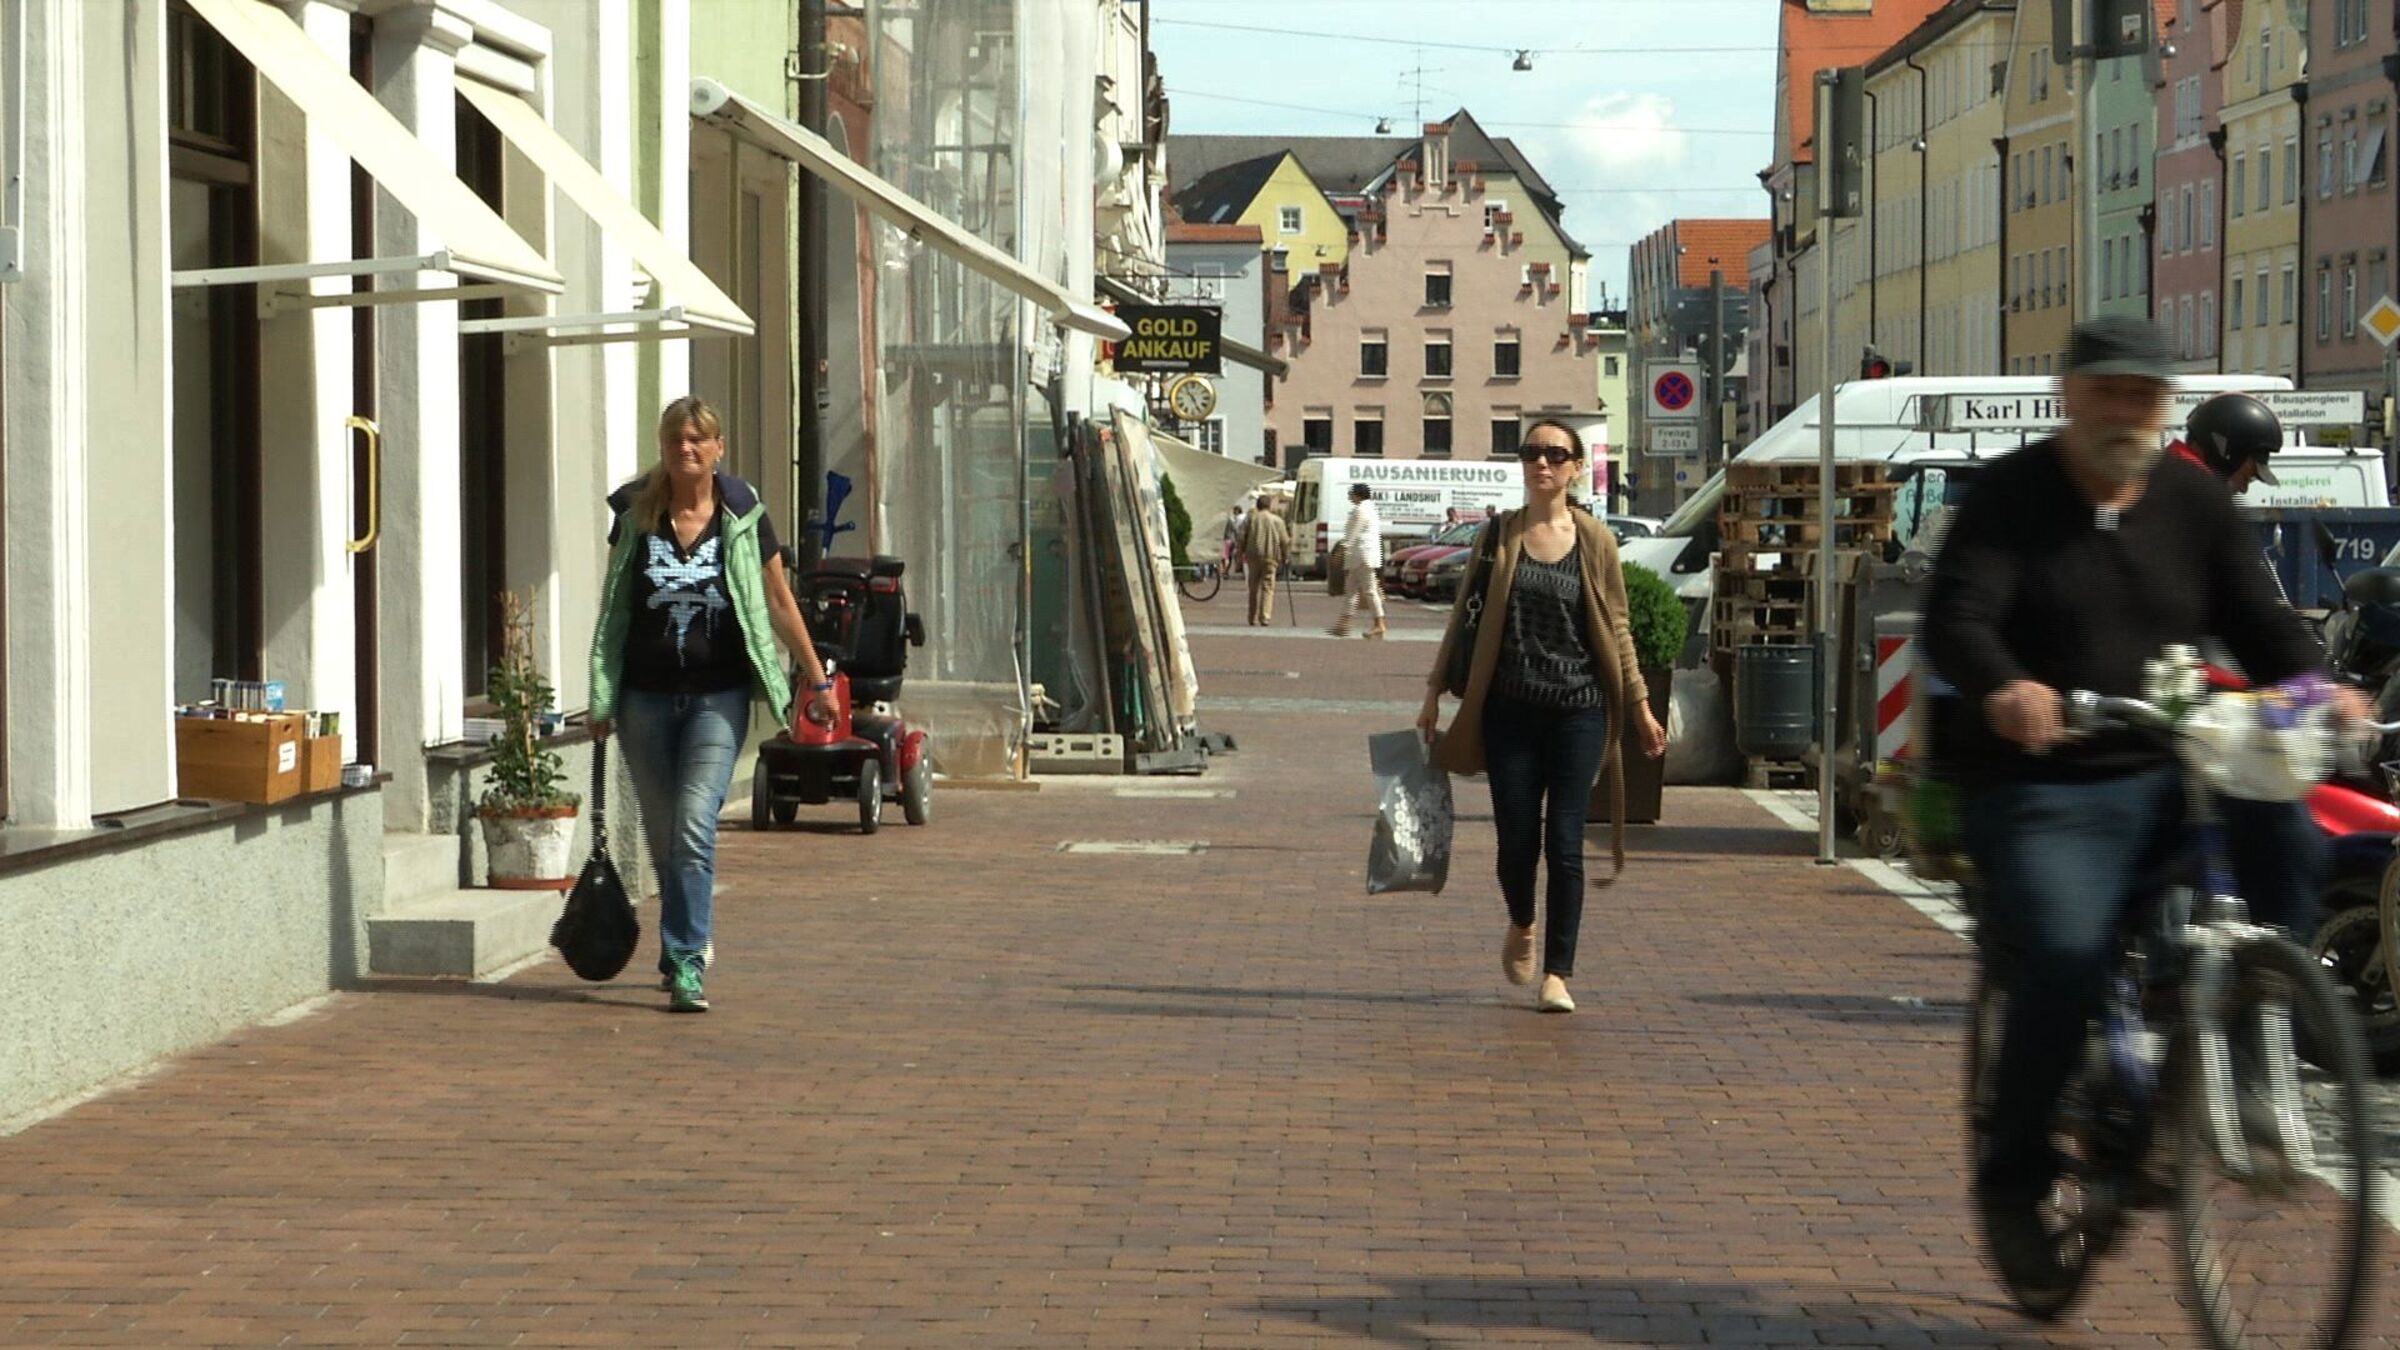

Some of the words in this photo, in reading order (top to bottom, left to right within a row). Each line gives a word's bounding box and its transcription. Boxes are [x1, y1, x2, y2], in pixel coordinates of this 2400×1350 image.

[1137, 318, 1198, 336] GOLD
[1123, 340, 1212, 359] ANKAUF
[1965, 399, 2021, 419] Karl
[2273, 394, 2350, 406] Bauspenglerei
[1658, 429, 1691, 439] Freitag
[1349, 465, 1508, 483] BAUSANIERUNG
[1394, 491, 1441, 503] LANDSHUT
[2334, 537, 2376, 560] 719
